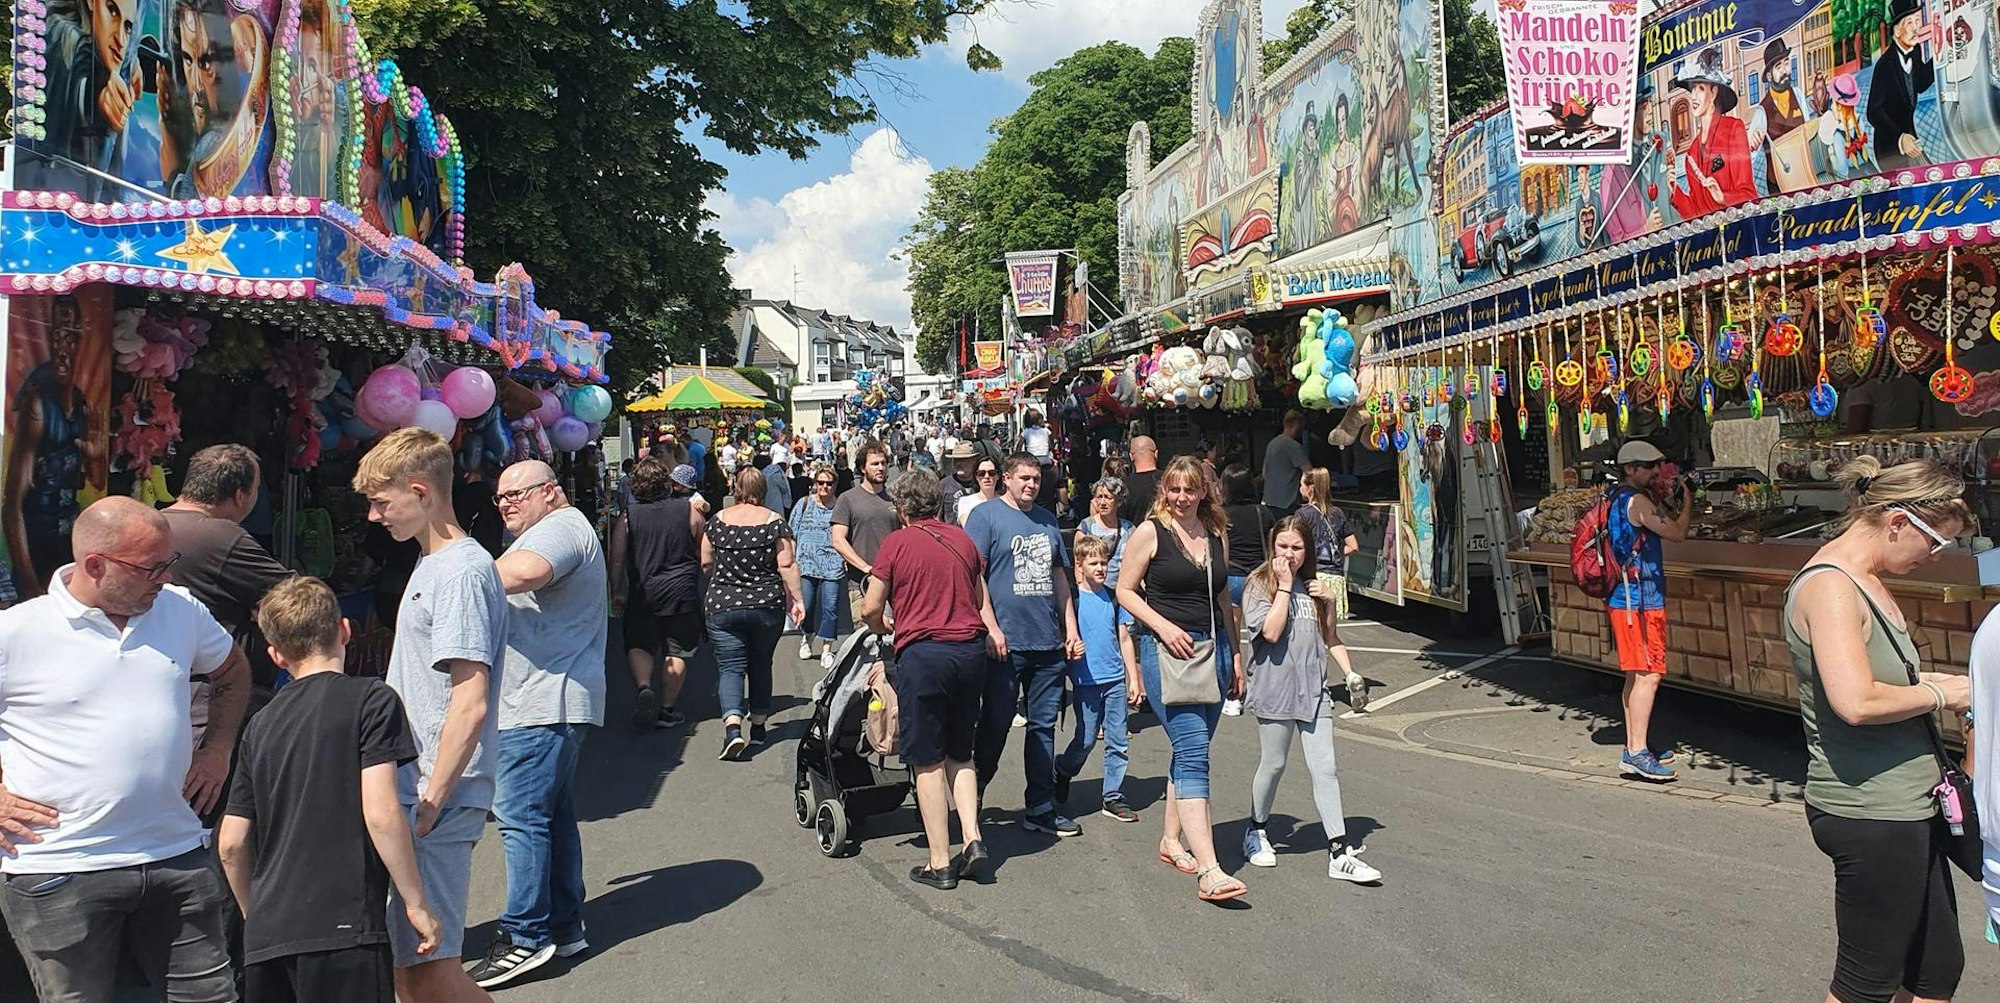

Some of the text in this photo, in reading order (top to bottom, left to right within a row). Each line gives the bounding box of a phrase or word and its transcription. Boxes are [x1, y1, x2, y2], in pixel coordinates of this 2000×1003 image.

[1510, 12, 1626, 42] Mandeln
[1644, 2, 1737, 65] Boutique
[1517, 46, 1627, 76] Schoko-
[1521, 77, 1620, 107] früchte
[1905, 288, 1937, 321] Ich
